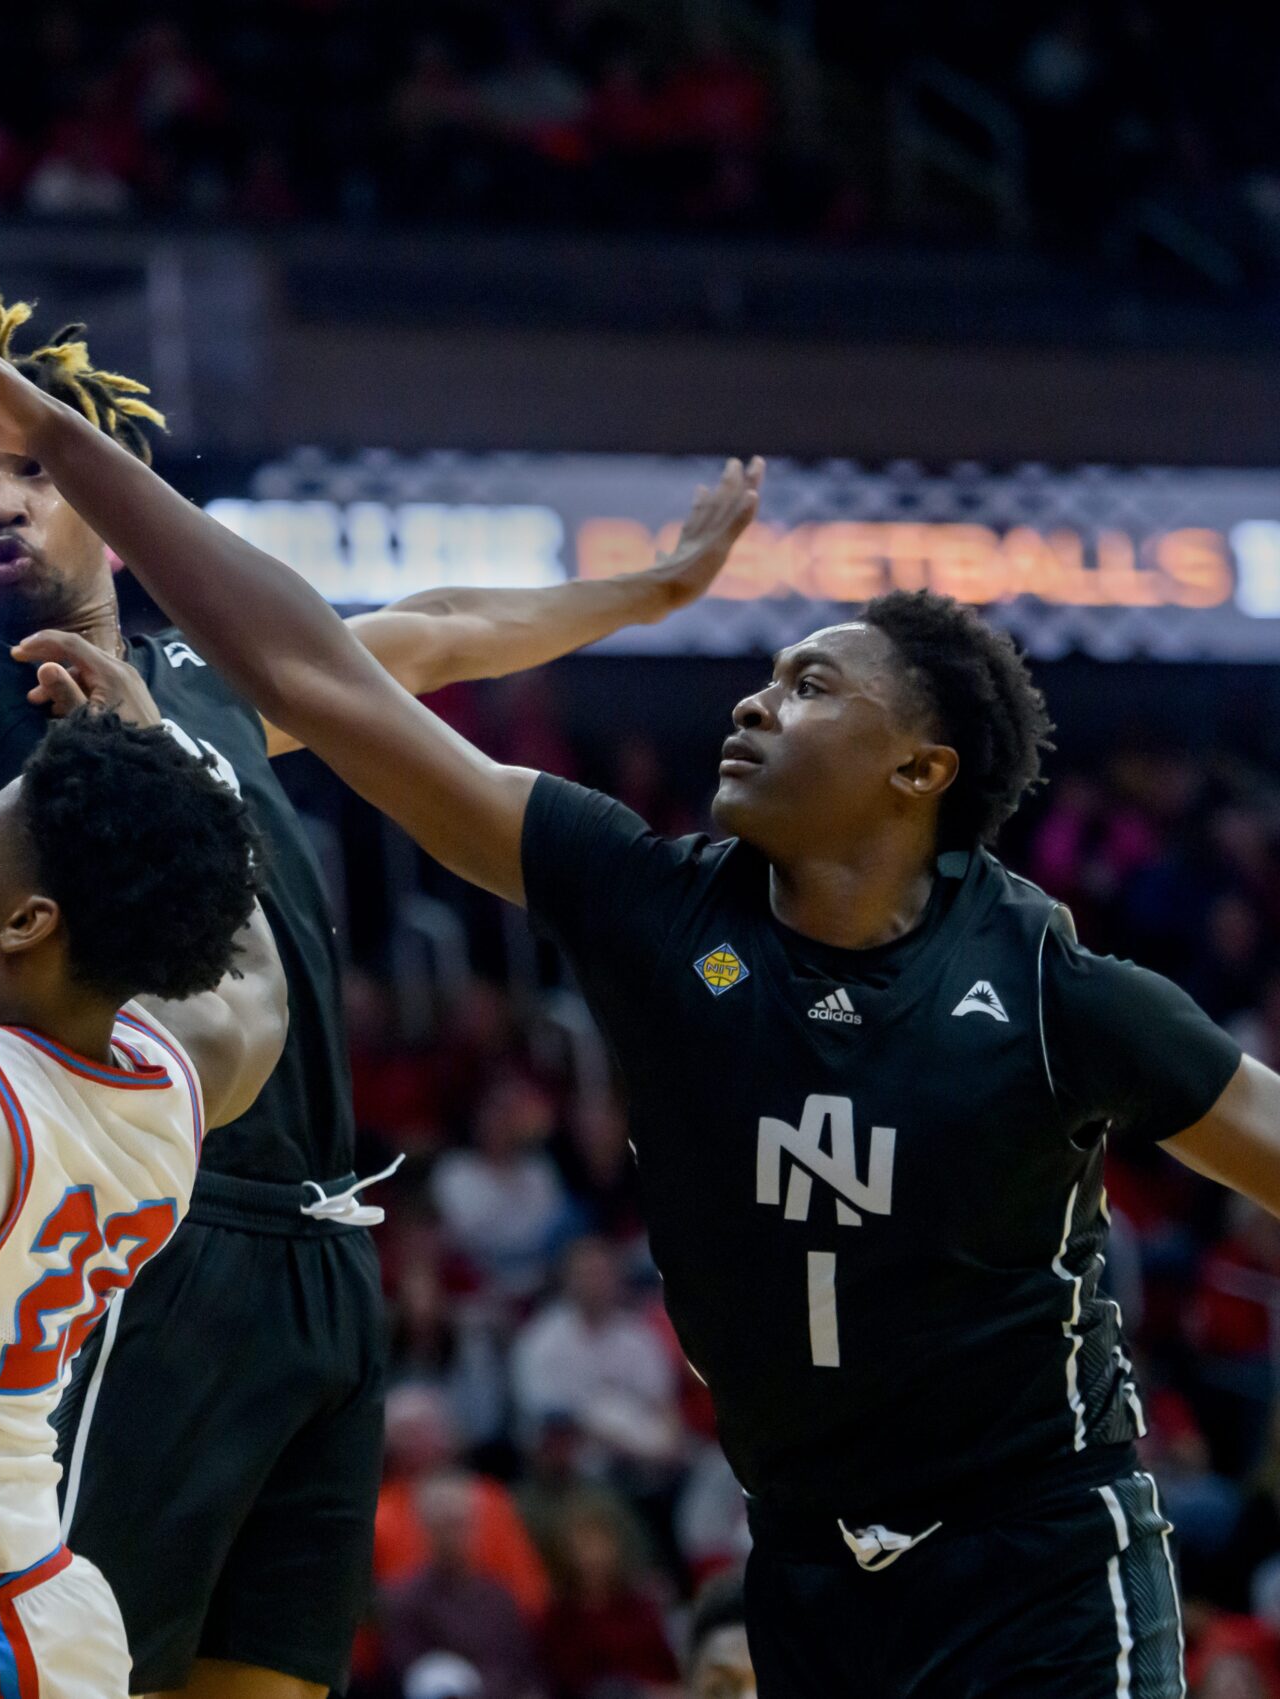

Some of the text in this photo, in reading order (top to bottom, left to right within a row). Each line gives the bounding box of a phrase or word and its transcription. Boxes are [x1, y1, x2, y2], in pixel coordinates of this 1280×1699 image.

[706, 963, 738, 976] NIT
[808, 1009, 862, 1024] adidas
[807, 1251, 840, 1367] 1
